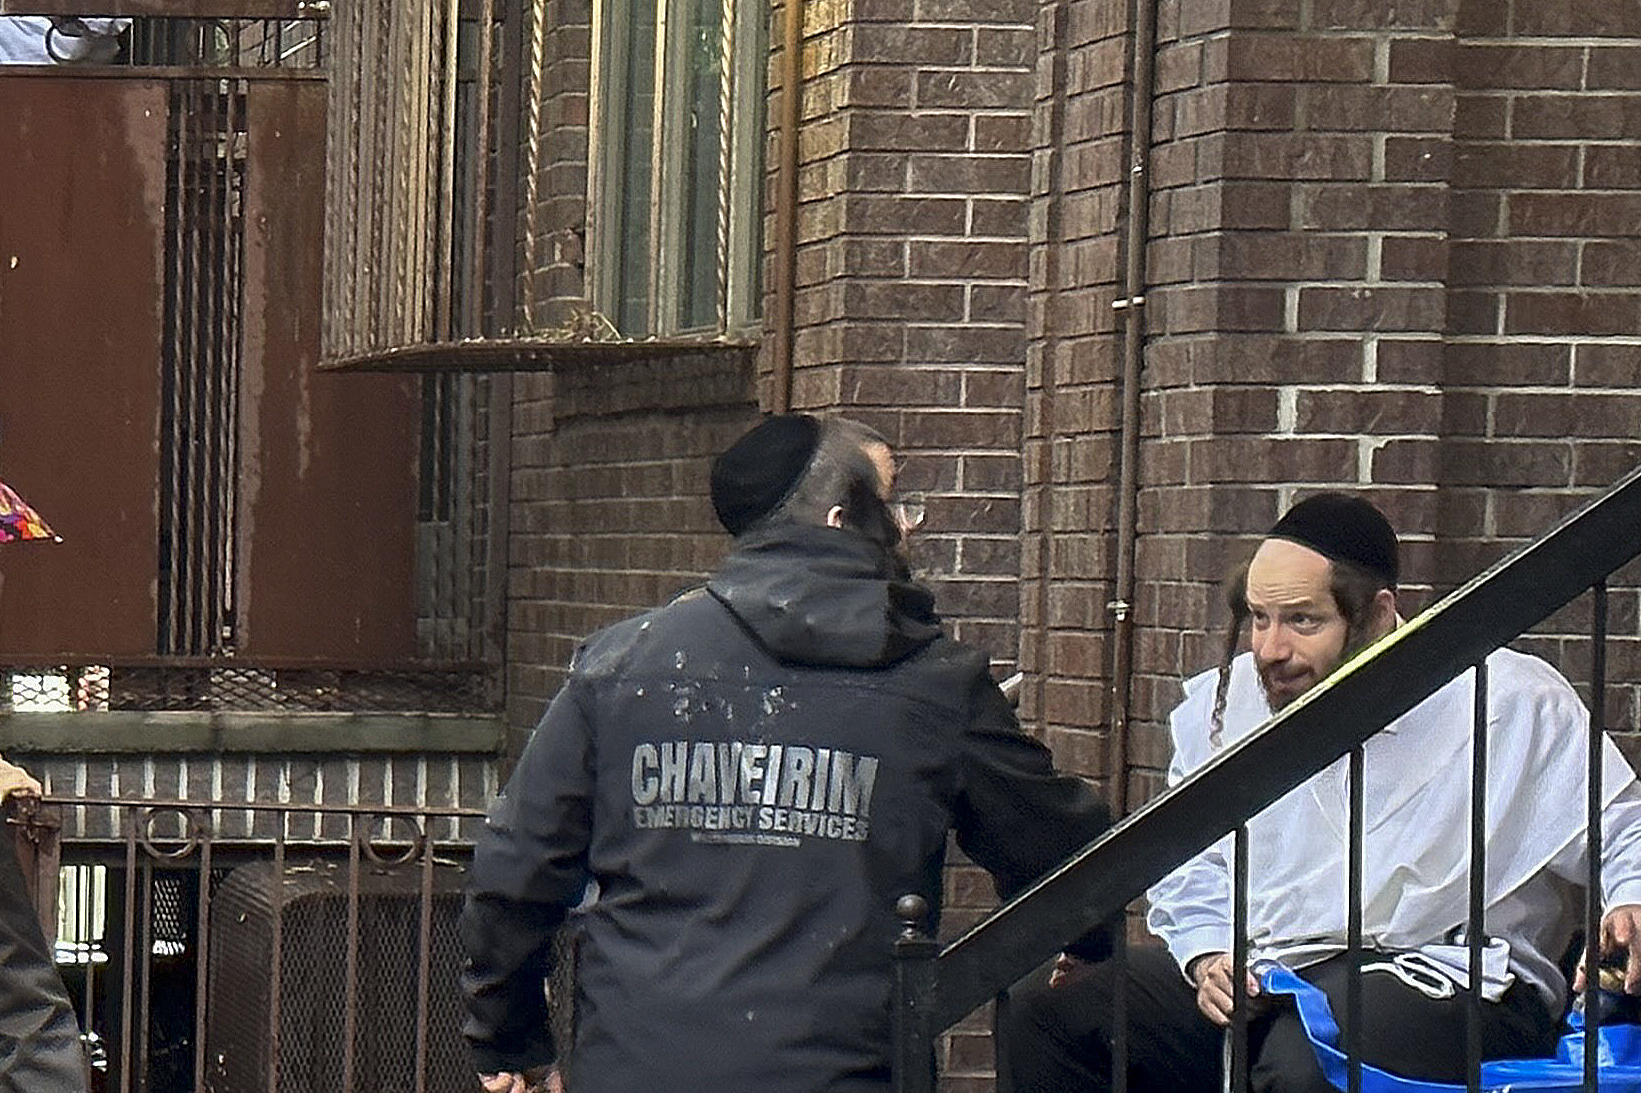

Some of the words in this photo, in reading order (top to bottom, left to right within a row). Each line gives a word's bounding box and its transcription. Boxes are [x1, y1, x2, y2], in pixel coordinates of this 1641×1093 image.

[631, 741, 878, 817] CHAVEIRIM
[633, 804, 753, 830] EMERGENCY
[758, 805, 870, 841] SERVICES
